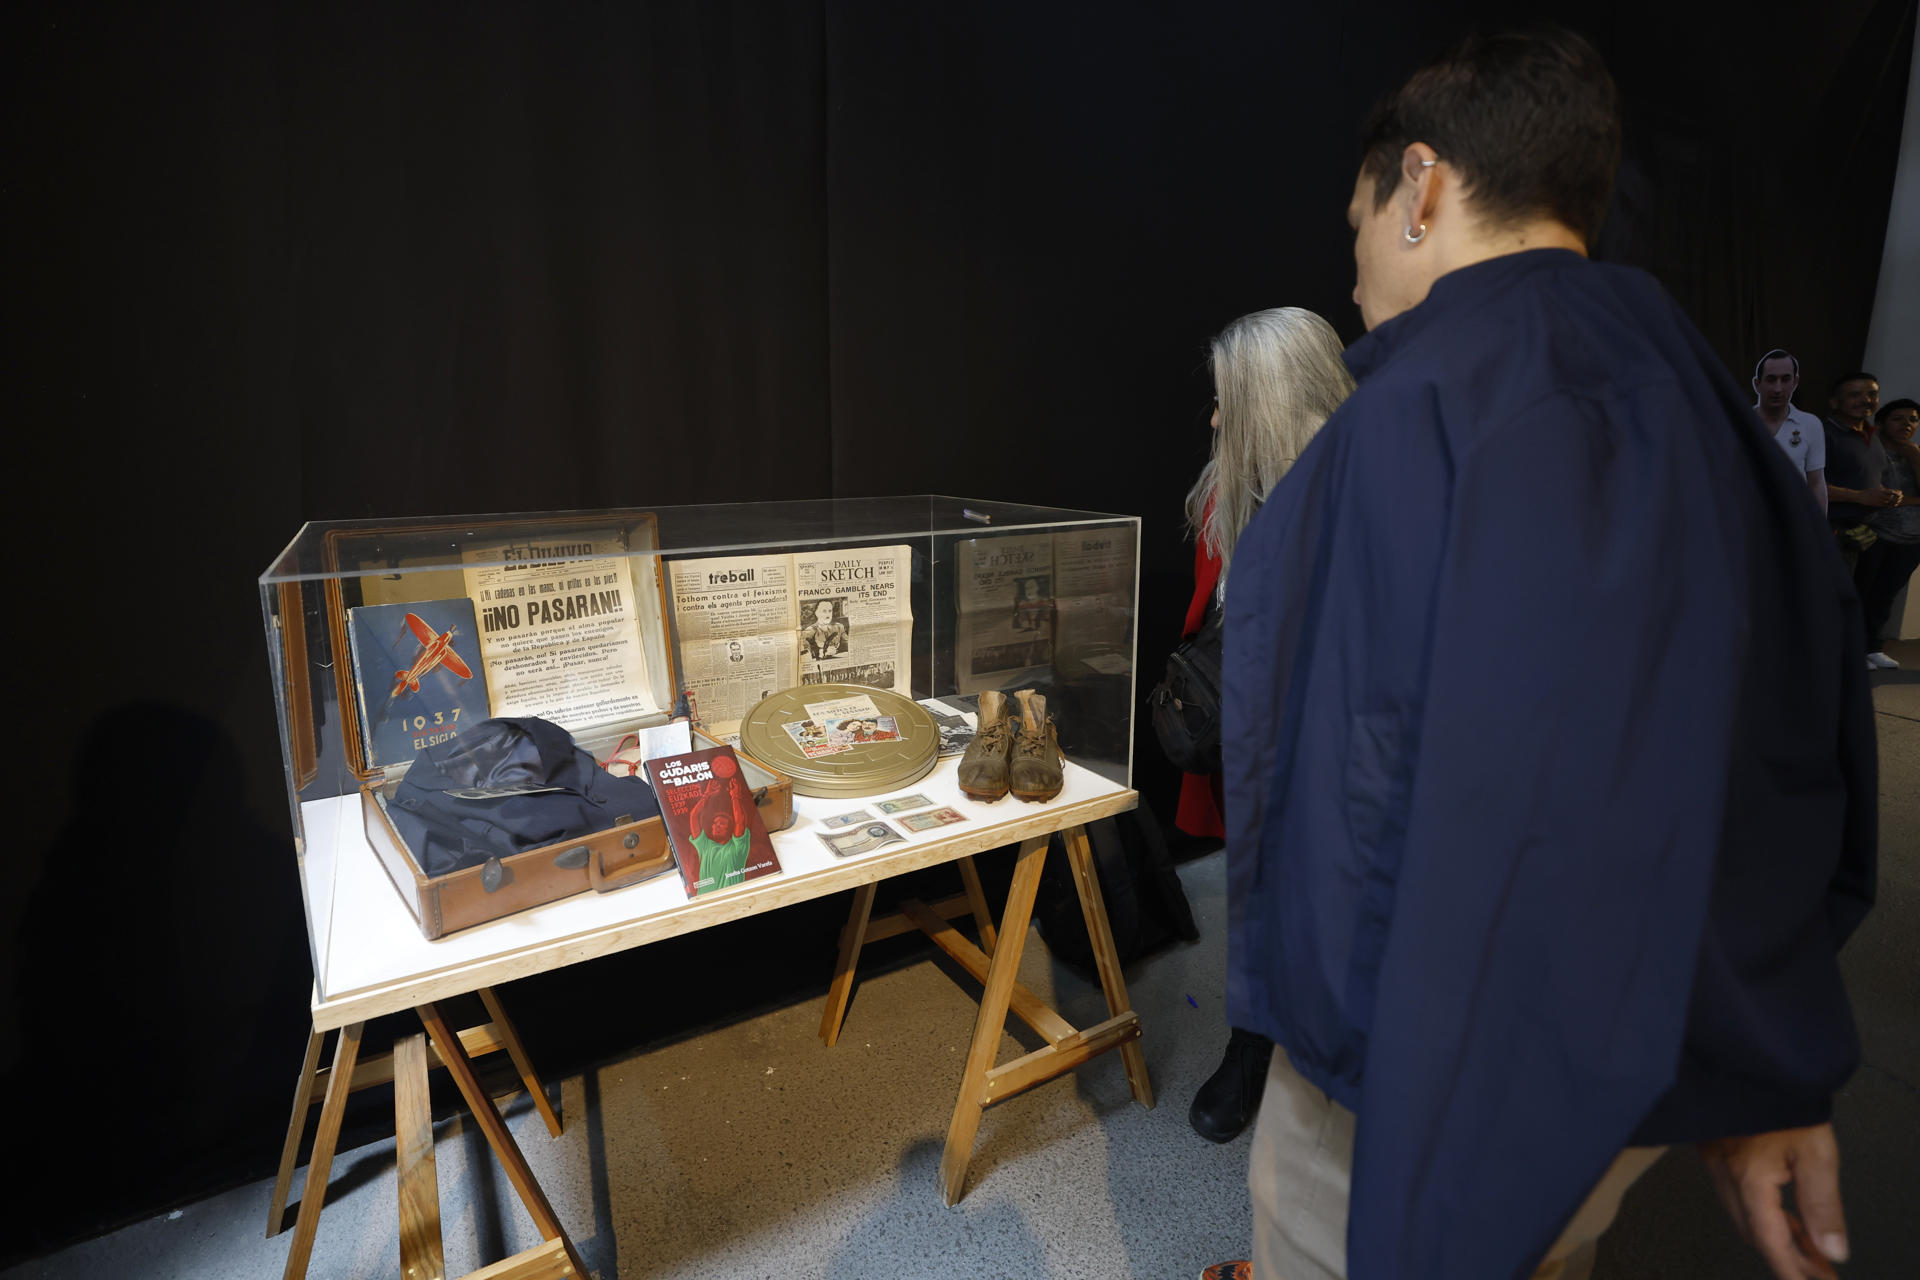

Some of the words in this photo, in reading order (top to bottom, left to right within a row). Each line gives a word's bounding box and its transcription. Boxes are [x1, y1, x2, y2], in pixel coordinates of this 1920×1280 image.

[834, 560, 862, 568] DAILY
[709, 568, 755, 584] treball
[821, 566, 874, 582] SKETCH
[494, 588, 516, 599] cadenas
[518, 586, 525, 597] en
[528, 584, 536, 595] las
[567, 578, 582, 590] grillos
[585, 577, 591, 587] en
[676, 594, 708, 604] Tothom
[712, 592, 738, 600] contra
[754, 587, 787, 597] feixisme
[798, 588, 831, 596] FRANCO
[836, 585, 866, 594] GAMBLE
[870, 582, 895, 590] NEARS
[720, 599, 742, 609] agents
[508, 632, 538, 641] pasarán
[541, 628, 565, 636] porque
[598, 618, 624, 626] popular
[512, 638, 534, 647] quiere
[584, 626, 614, 634] enemigos
[582, 634, 606, 642] España
[504, 659, 548, 671] deshonrados
[413, 738, 428, 751] EL
[660, 762, 710, 779] GUDARIS
[665, 760, 682, 769] LOS
